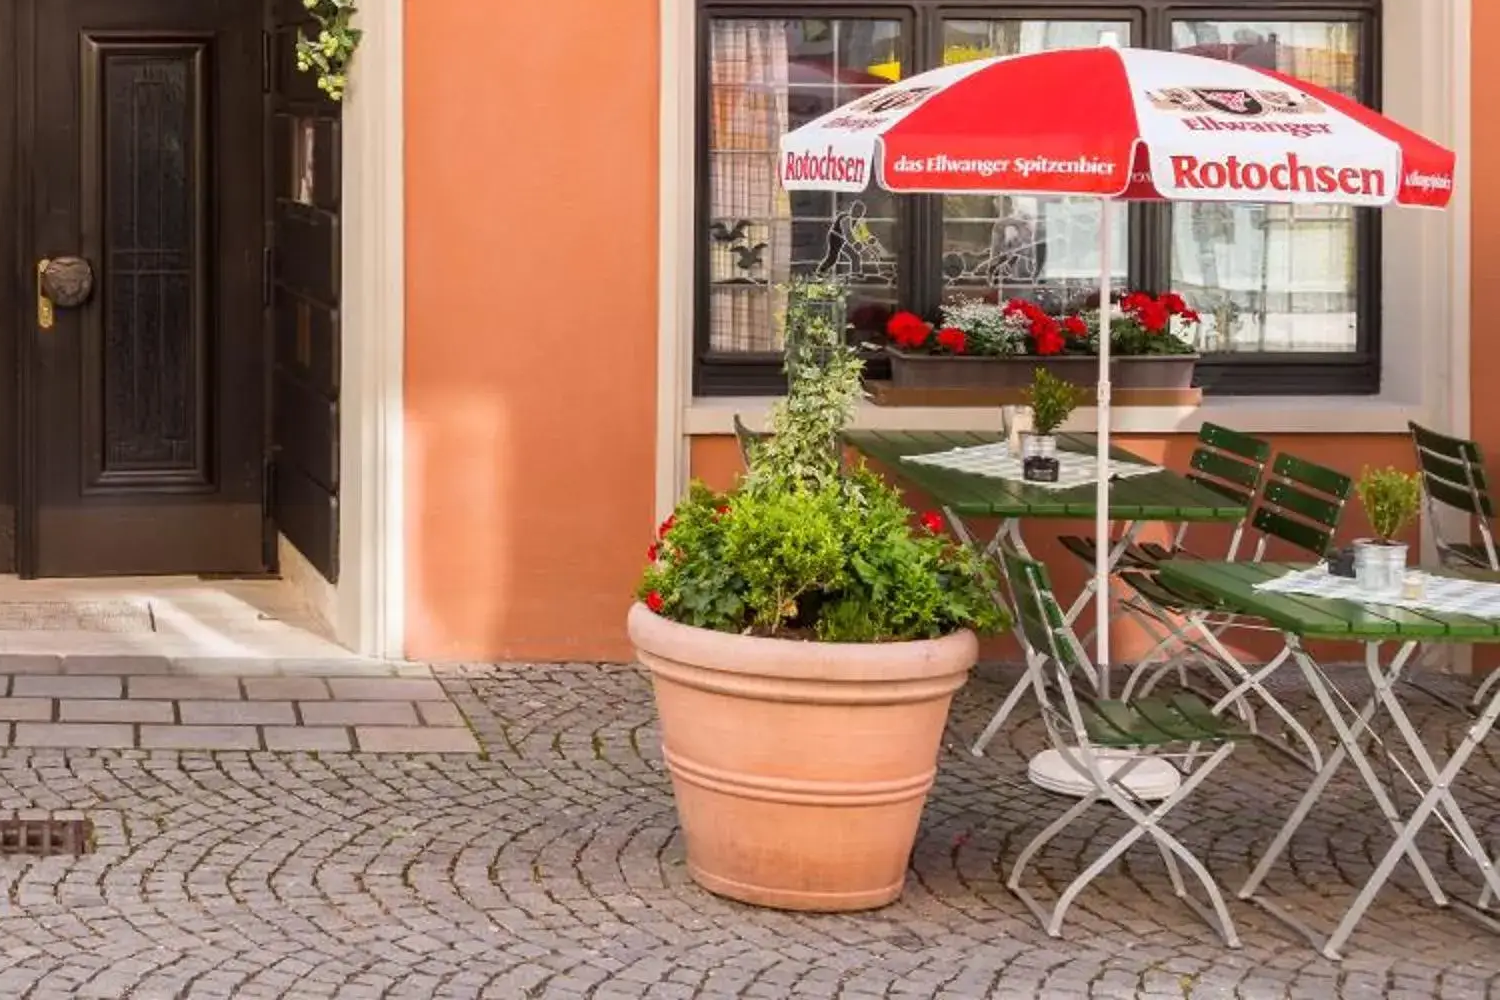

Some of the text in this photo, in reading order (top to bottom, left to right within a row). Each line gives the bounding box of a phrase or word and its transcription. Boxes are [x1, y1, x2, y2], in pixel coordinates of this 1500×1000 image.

[1180, 115, 1334, 139] Ellwanger
[784, 144, 865, 184] Rotochsen
[893, 154, 923, 172] das
[926, 154, 1008, 177] Ellwanger
[1013, 155, 1116, 178] Spitzenbier
[1170, 151, 1385, 197] Rotochsen
